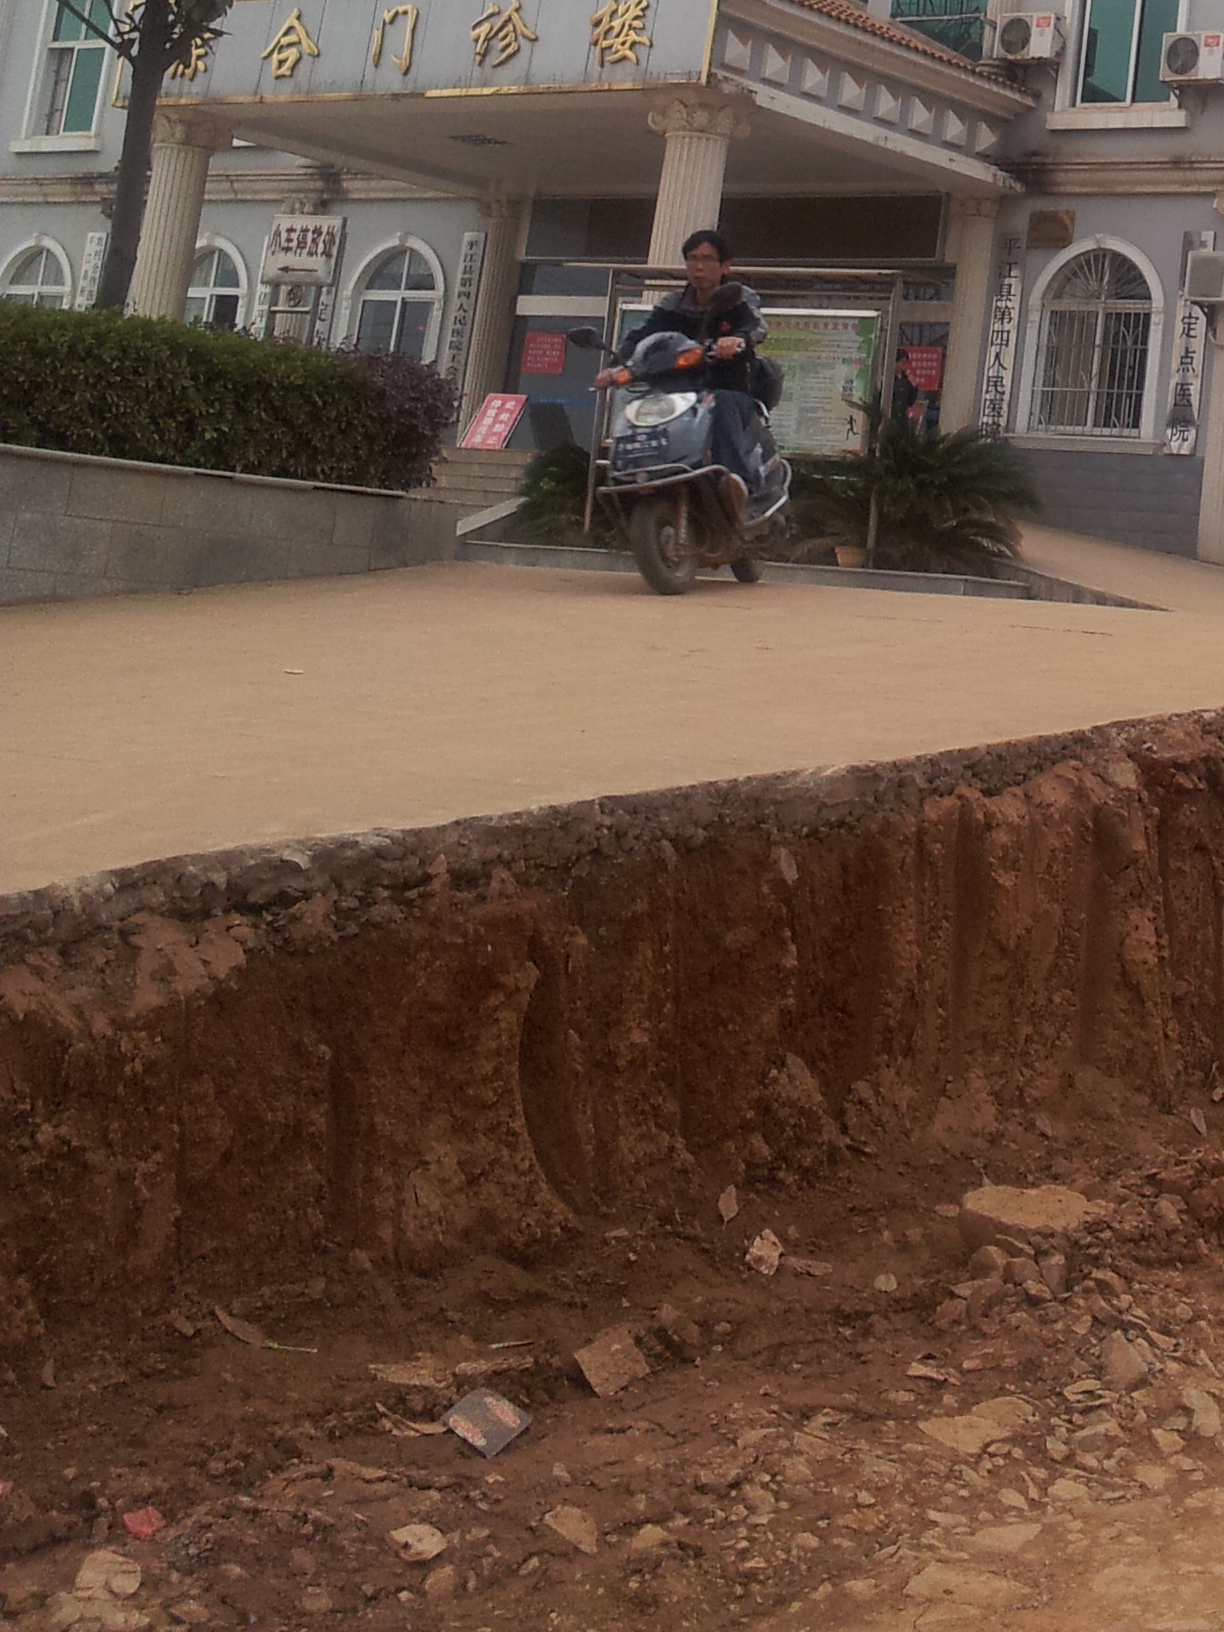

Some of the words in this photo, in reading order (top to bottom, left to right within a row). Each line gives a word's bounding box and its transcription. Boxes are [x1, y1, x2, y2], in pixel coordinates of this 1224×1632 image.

[269, 223, 336, 260] 小车停放处
[979, 236, 1022, 442] 平江县第四人民医院
